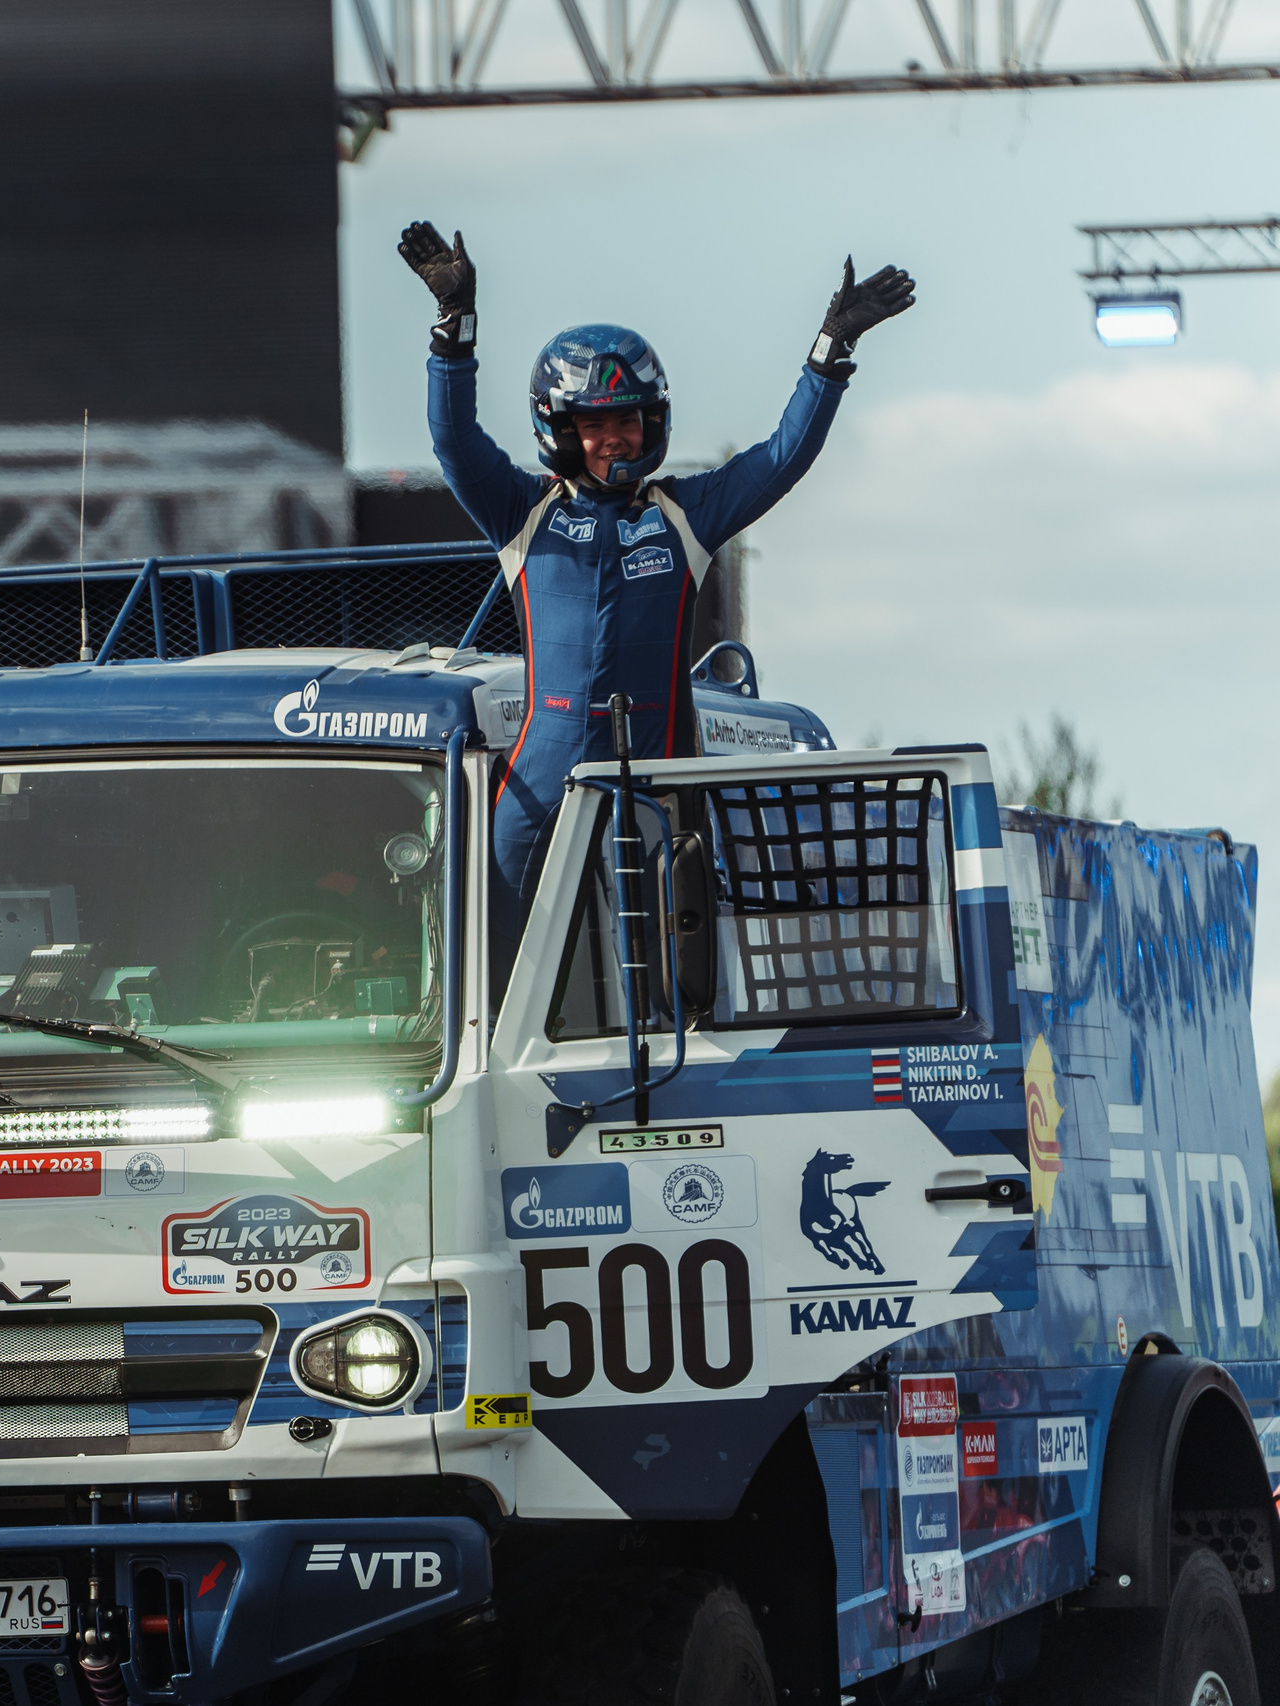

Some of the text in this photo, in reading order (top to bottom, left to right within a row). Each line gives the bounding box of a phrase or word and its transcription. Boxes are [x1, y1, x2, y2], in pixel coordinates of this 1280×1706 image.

[591, 394, 642, 405] TATNEFT
[568, 523, 592, 539] VTB
[627, 557, 668, 571] KAMAZ
[318, 712, 428, 738] ГАЗПРОМ
[1011, 901, 1038, 921] АРТНЕР
[907, 1044, 998, 1063] SHIBALOV A.
[908, 1064, 981, 1083] NIKITIN D.
[909, 1083, 1003, 1103] TATARINOV I.
[609, 1132, 714, 1148] 43509
[49, 1157, 93, 1171] 2023
[237, 1208, 291, 1221] 2023
[545, 1205, 623, 1228] GAZPROM
[672, 1203, 716, 1214] CAMF
[180, 1223, 351, 1250] SILK WAY
[1151, 1150, 1263, 1329] VTB
[232, 1250, 299, 1261] RALLY
[188, 1275, 225, 1285] GAZPROM
[235, 1268, 297, 1293] 500
[520, 1238, 754, 1398] 500
[789, 1296, 917, 1335] KAMAZ
[917, 1454, 954, 1474] ГАЗПРОМБАНК
[348, 1551, 442, 1591] VTB
[10, 1617, 40, 1630] RUS
